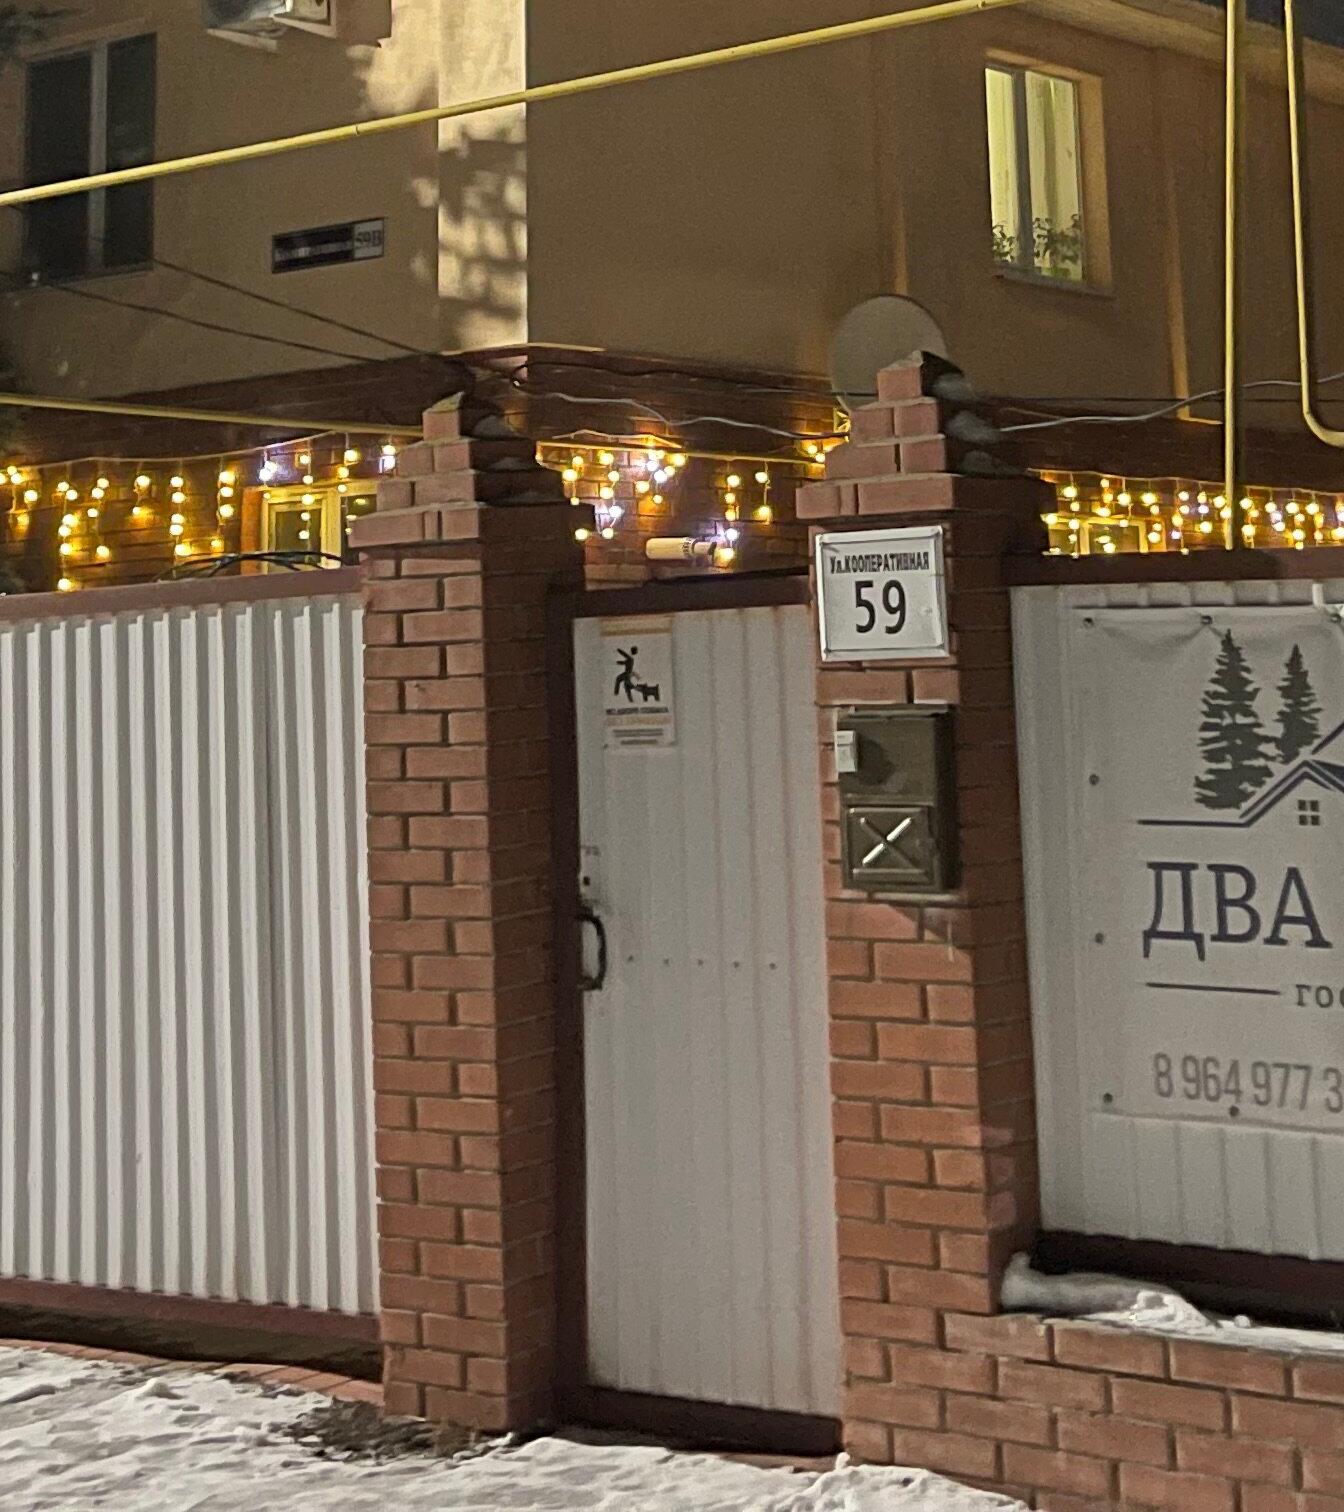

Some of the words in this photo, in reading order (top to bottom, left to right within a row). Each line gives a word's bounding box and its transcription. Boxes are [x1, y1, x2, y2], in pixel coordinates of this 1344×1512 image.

[854, 579, 907, 635] 59
[1142, 861, 1334, 962] ДВА
[1153, 1052, 1174, 1098] 8
[1181, 1054, 1243, 1103] 964
[1250, 1060, 1312, 1111] 977
